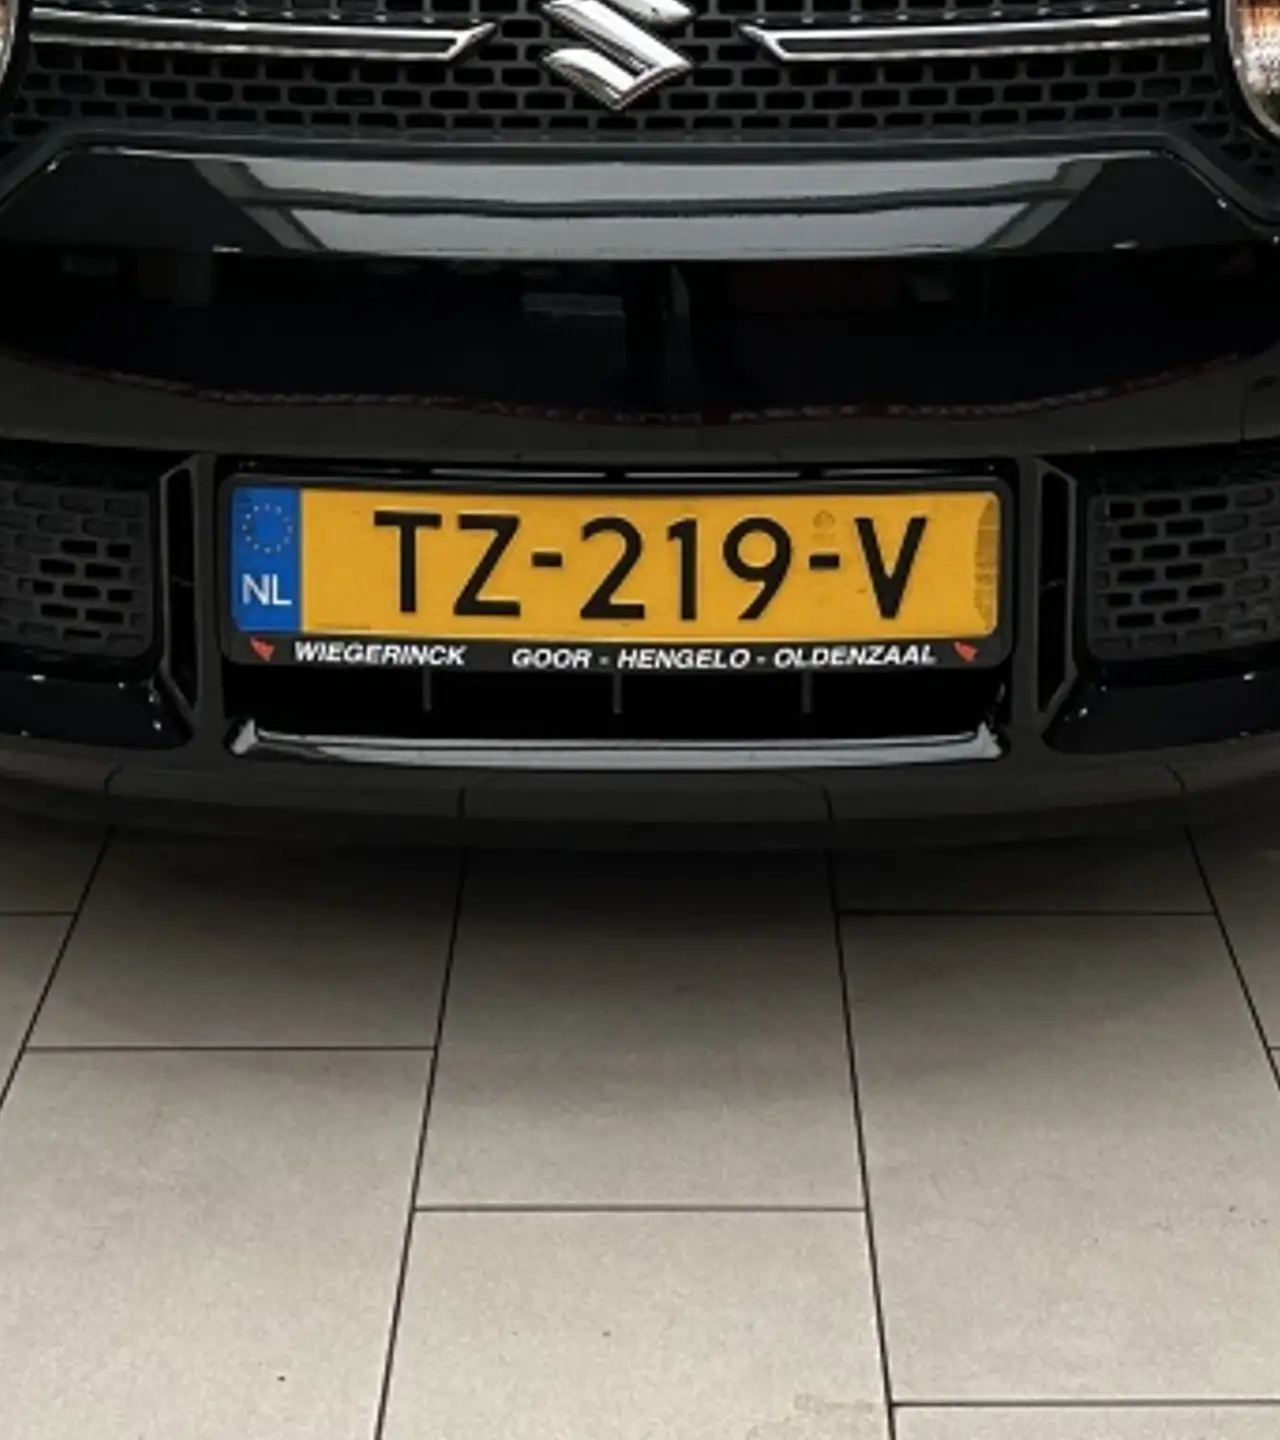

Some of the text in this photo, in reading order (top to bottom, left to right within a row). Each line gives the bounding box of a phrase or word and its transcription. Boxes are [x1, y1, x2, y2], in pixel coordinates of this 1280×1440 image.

[373, 510, 928, 621] TZ-219-V
[242, 573, 293, 606] NL
[294, 640, 468, 667] WIEGERINCK
[510, 648, 594, 670] GOOR
[617, 647, 751, 670] HENGELO
[773, 644, 938, 669] OLDENZAAL
